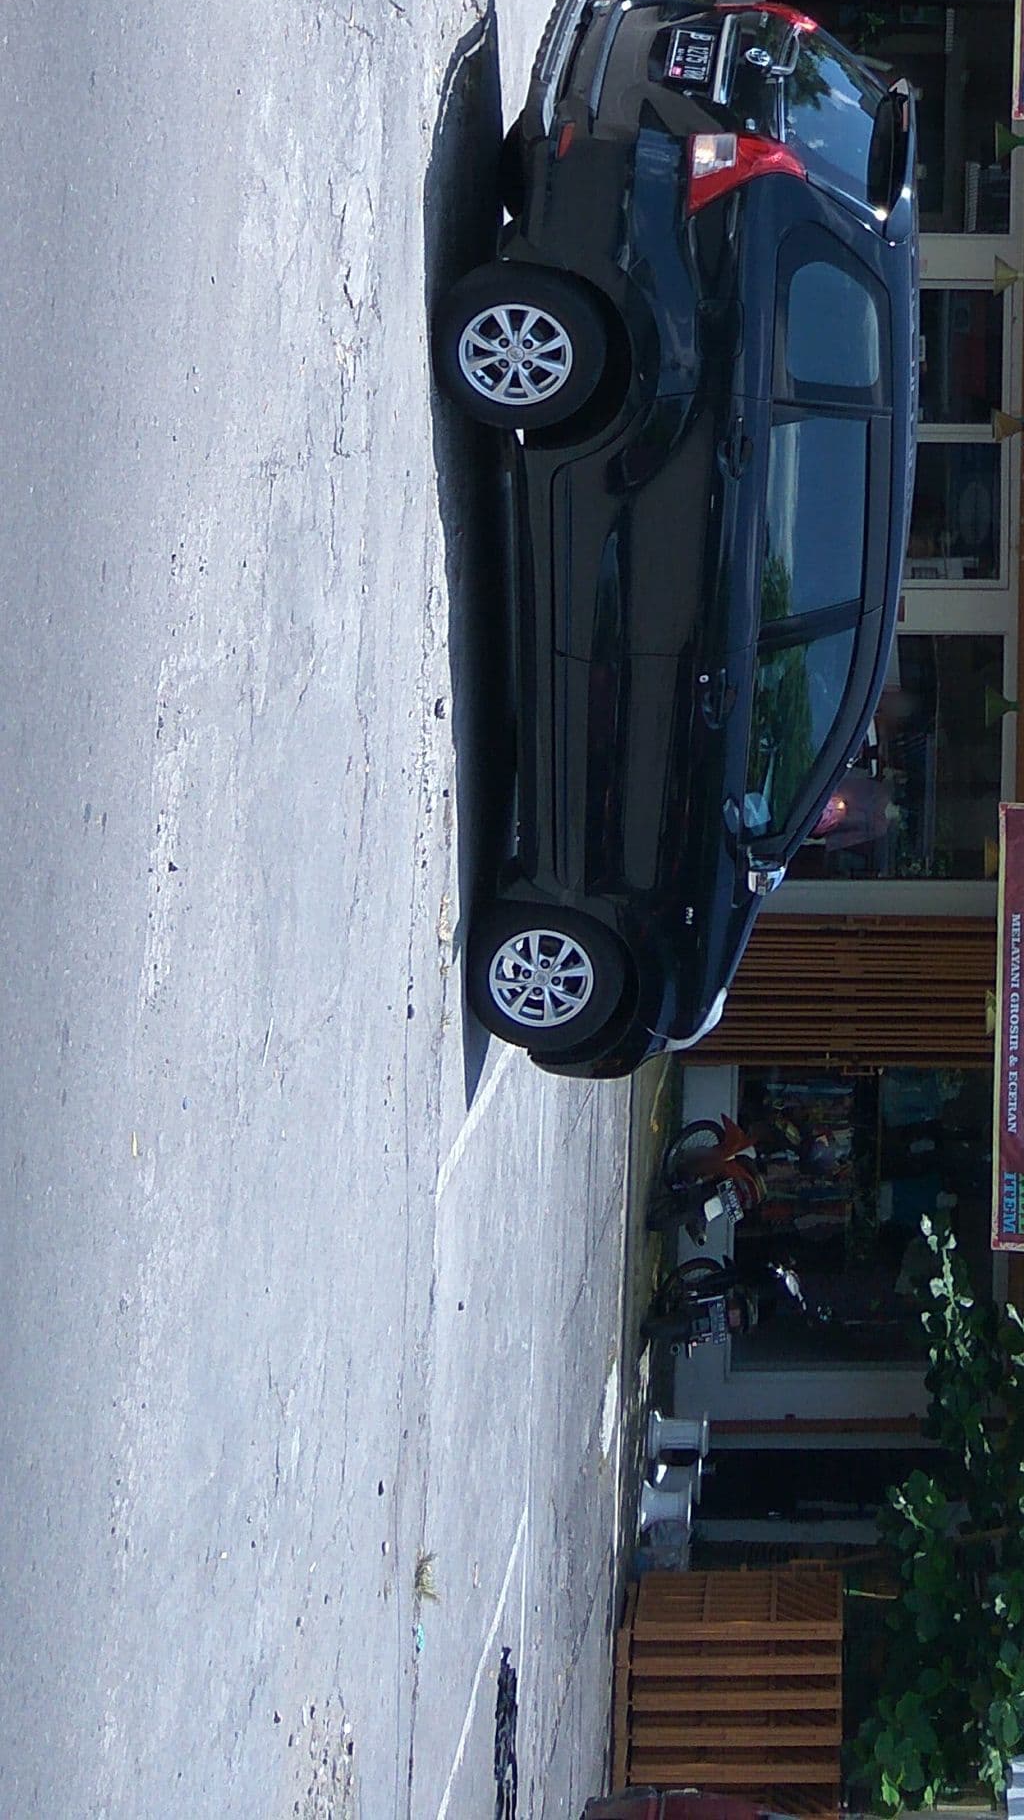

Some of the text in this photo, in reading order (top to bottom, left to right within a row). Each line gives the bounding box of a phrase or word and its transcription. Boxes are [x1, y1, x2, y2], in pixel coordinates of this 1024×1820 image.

[1007, 914, 1022, 1133] MELAYANI GROSIR & ECERAN
[1002, 1172, 1018, 1234] ITEM
